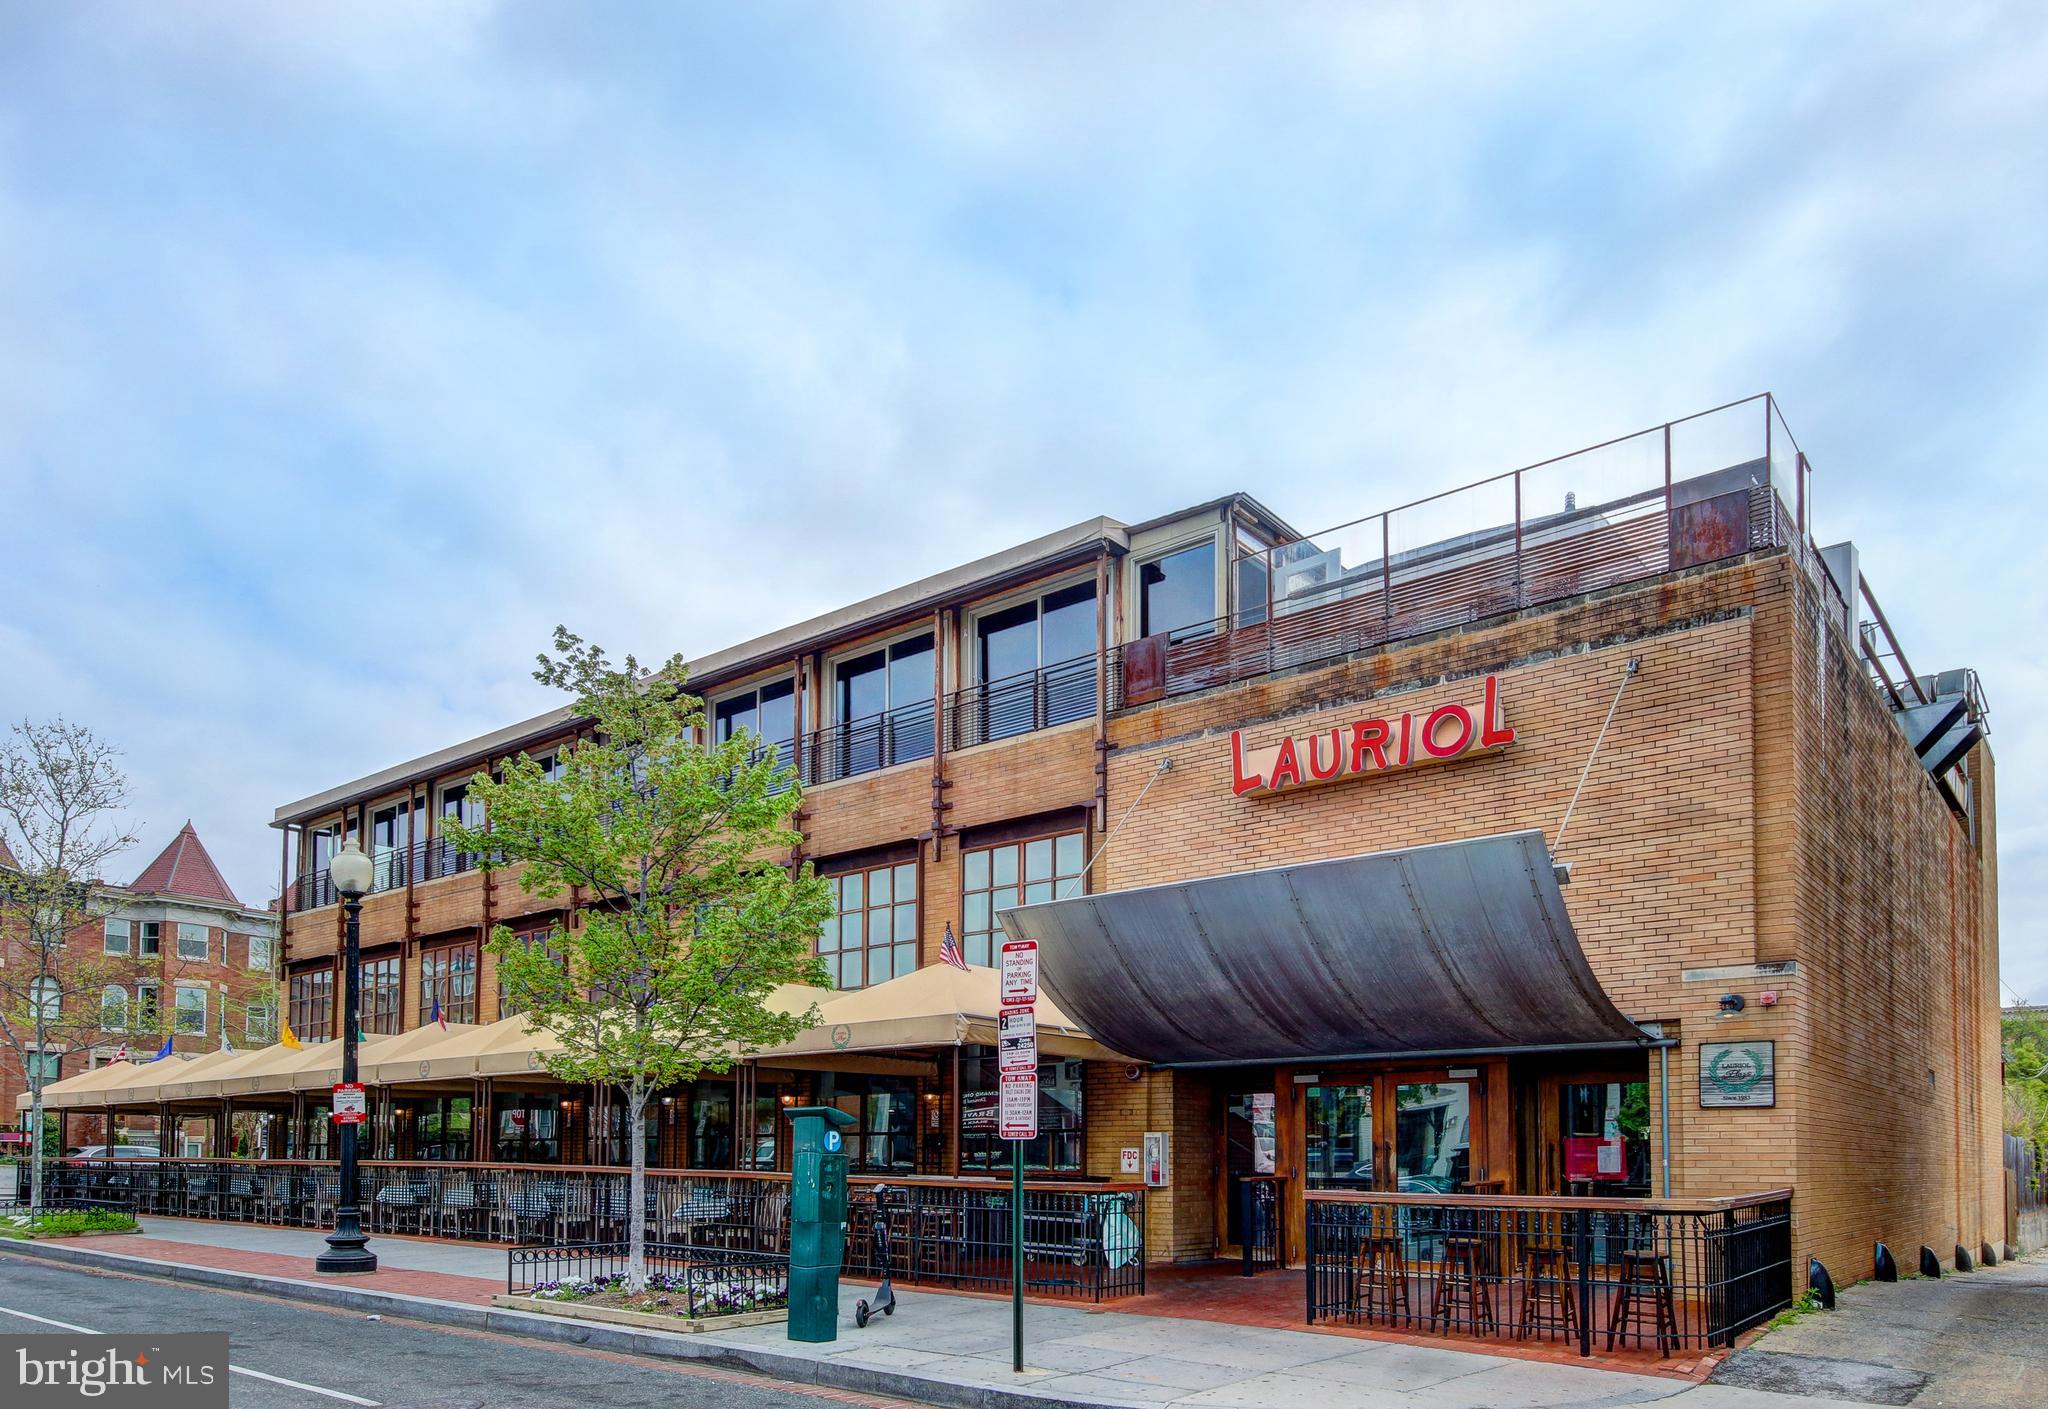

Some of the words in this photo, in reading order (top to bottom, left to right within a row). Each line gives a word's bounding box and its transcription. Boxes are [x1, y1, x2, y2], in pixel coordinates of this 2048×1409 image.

[1230, 675, 1518, 796] LAURIOL
[1005, 959, 1034, 967] STANDING
[1001, 1017, 1008, 1030] 2
[829, 1131, 840, 1151] P
[1122, 1150, 1138, 1160] FDC
